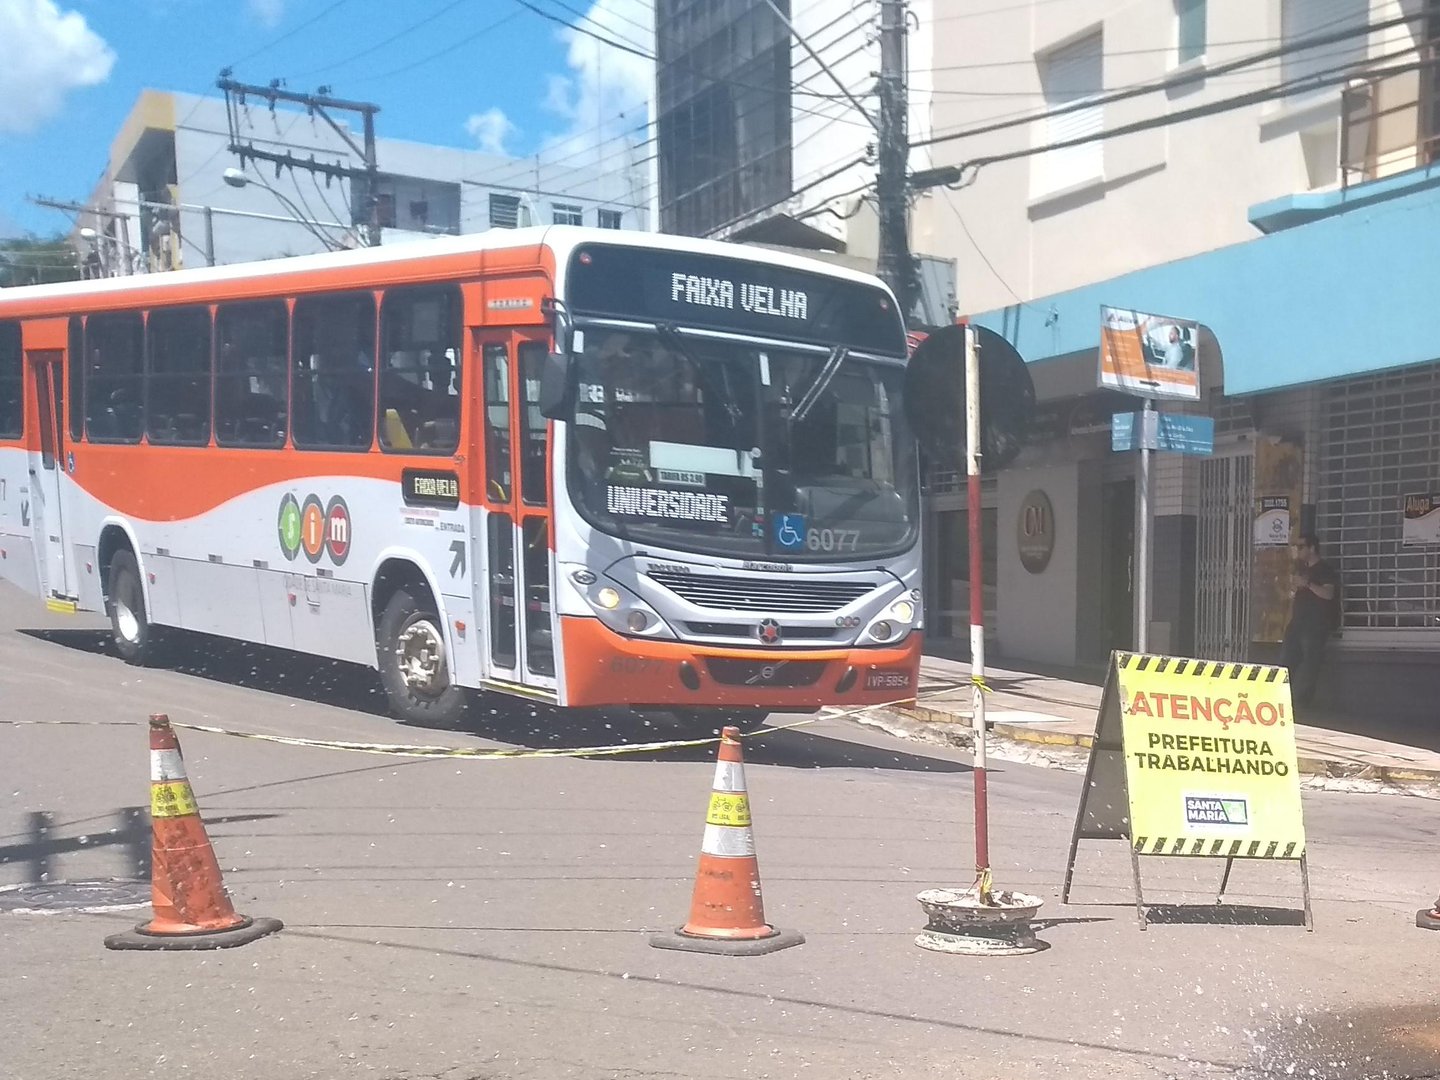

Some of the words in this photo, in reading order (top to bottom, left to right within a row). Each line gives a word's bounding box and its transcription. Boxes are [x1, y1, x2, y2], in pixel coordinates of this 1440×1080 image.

[671, 272, 734, 309] FAIXA
[740, 283, 807, 320] VELHA
[607, 485, 728, 523] UNIVERSIDADE
[807, 528, 860, 551] 6077
[1130, 691, 1286, 730] ATENÇÃO!
[1148, 732, 1274, 756] PREFEITURA
[1134, 752, 1289, 777] TRABALHANDO
[1187, 800, 1223, 811] SANTA
[1188, 810, 1228, 822] MARIA
